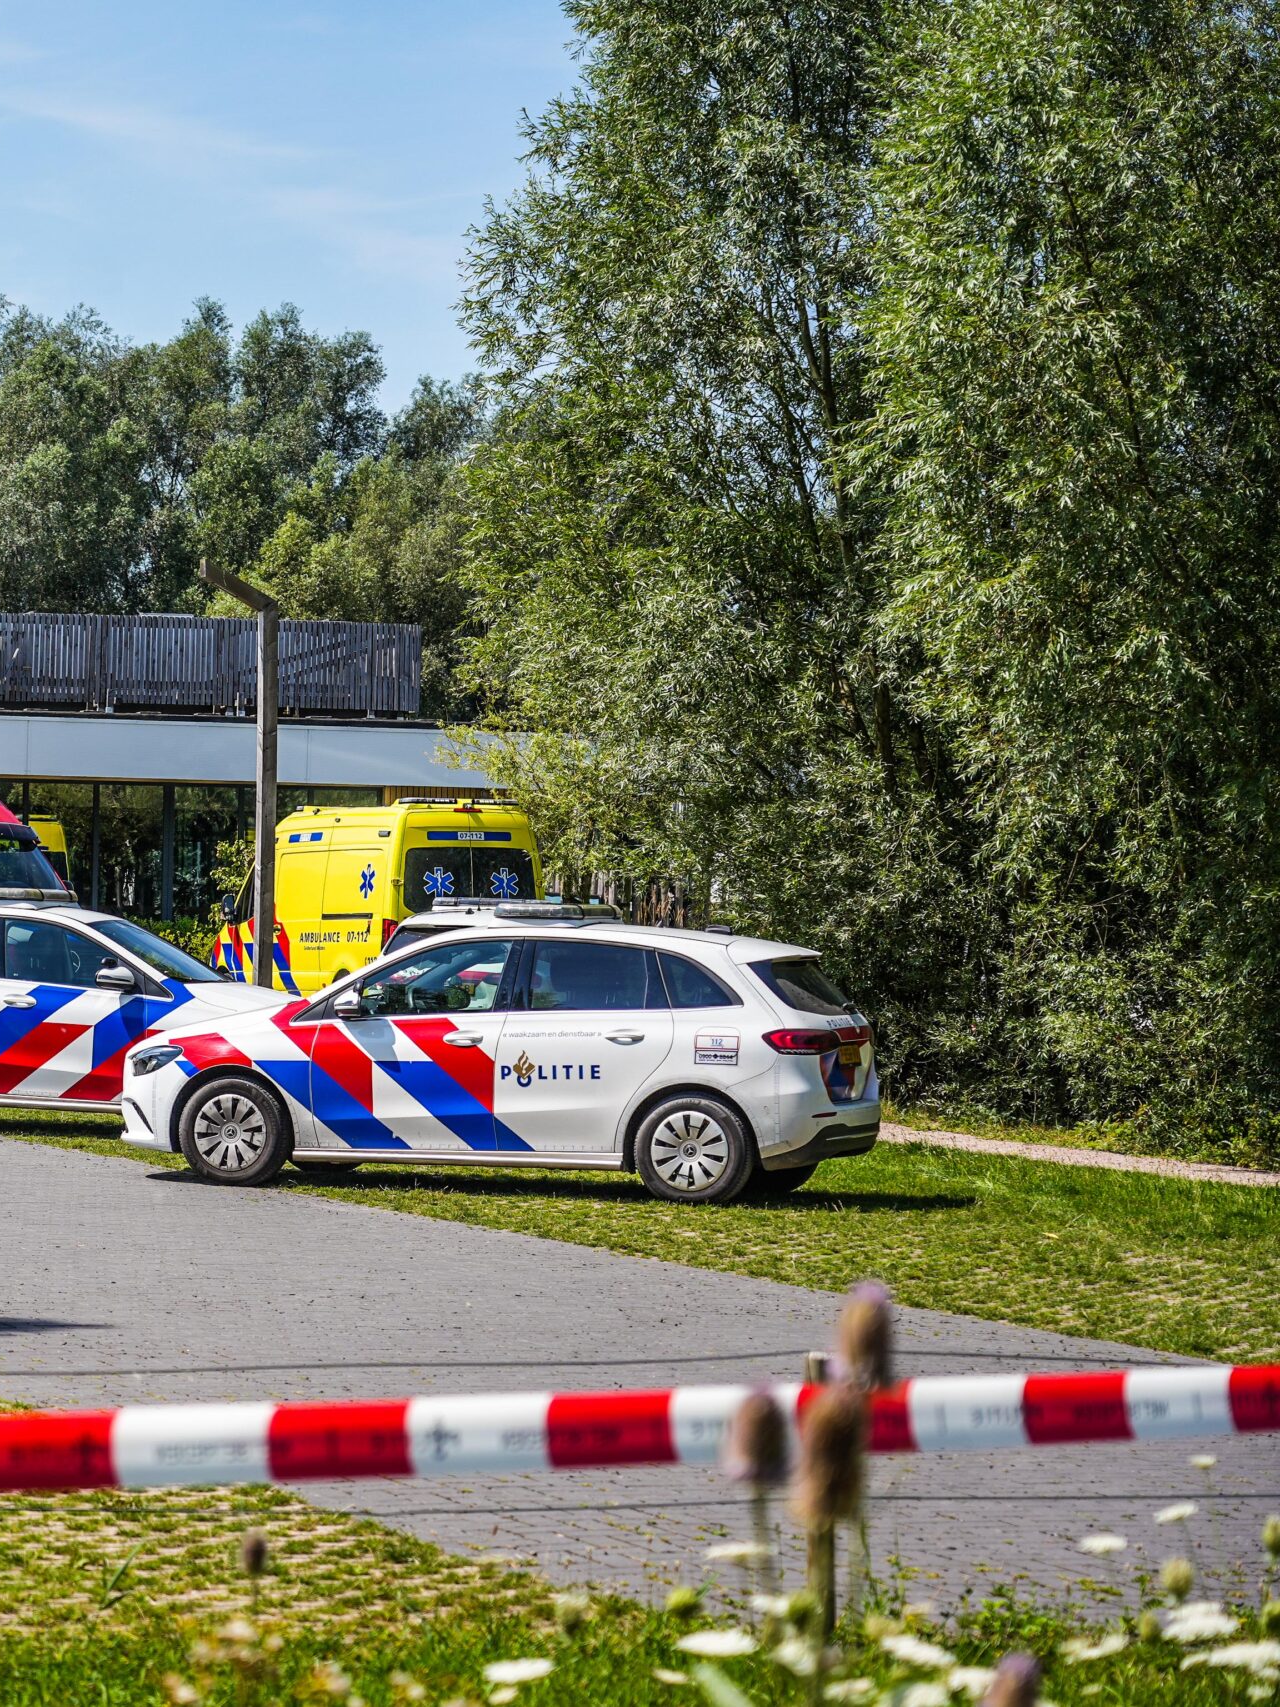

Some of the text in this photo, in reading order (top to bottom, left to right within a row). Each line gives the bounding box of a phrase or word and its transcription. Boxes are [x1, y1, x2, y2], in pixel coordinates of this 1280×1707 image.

[459, 832, 483, 840] 07-112
[299, 930, 369, 943] AMBULANCE 07-112
[557, 1030, 596, 1038] dienstbaar
[500, 1065, 601, 1087] POLITIE
